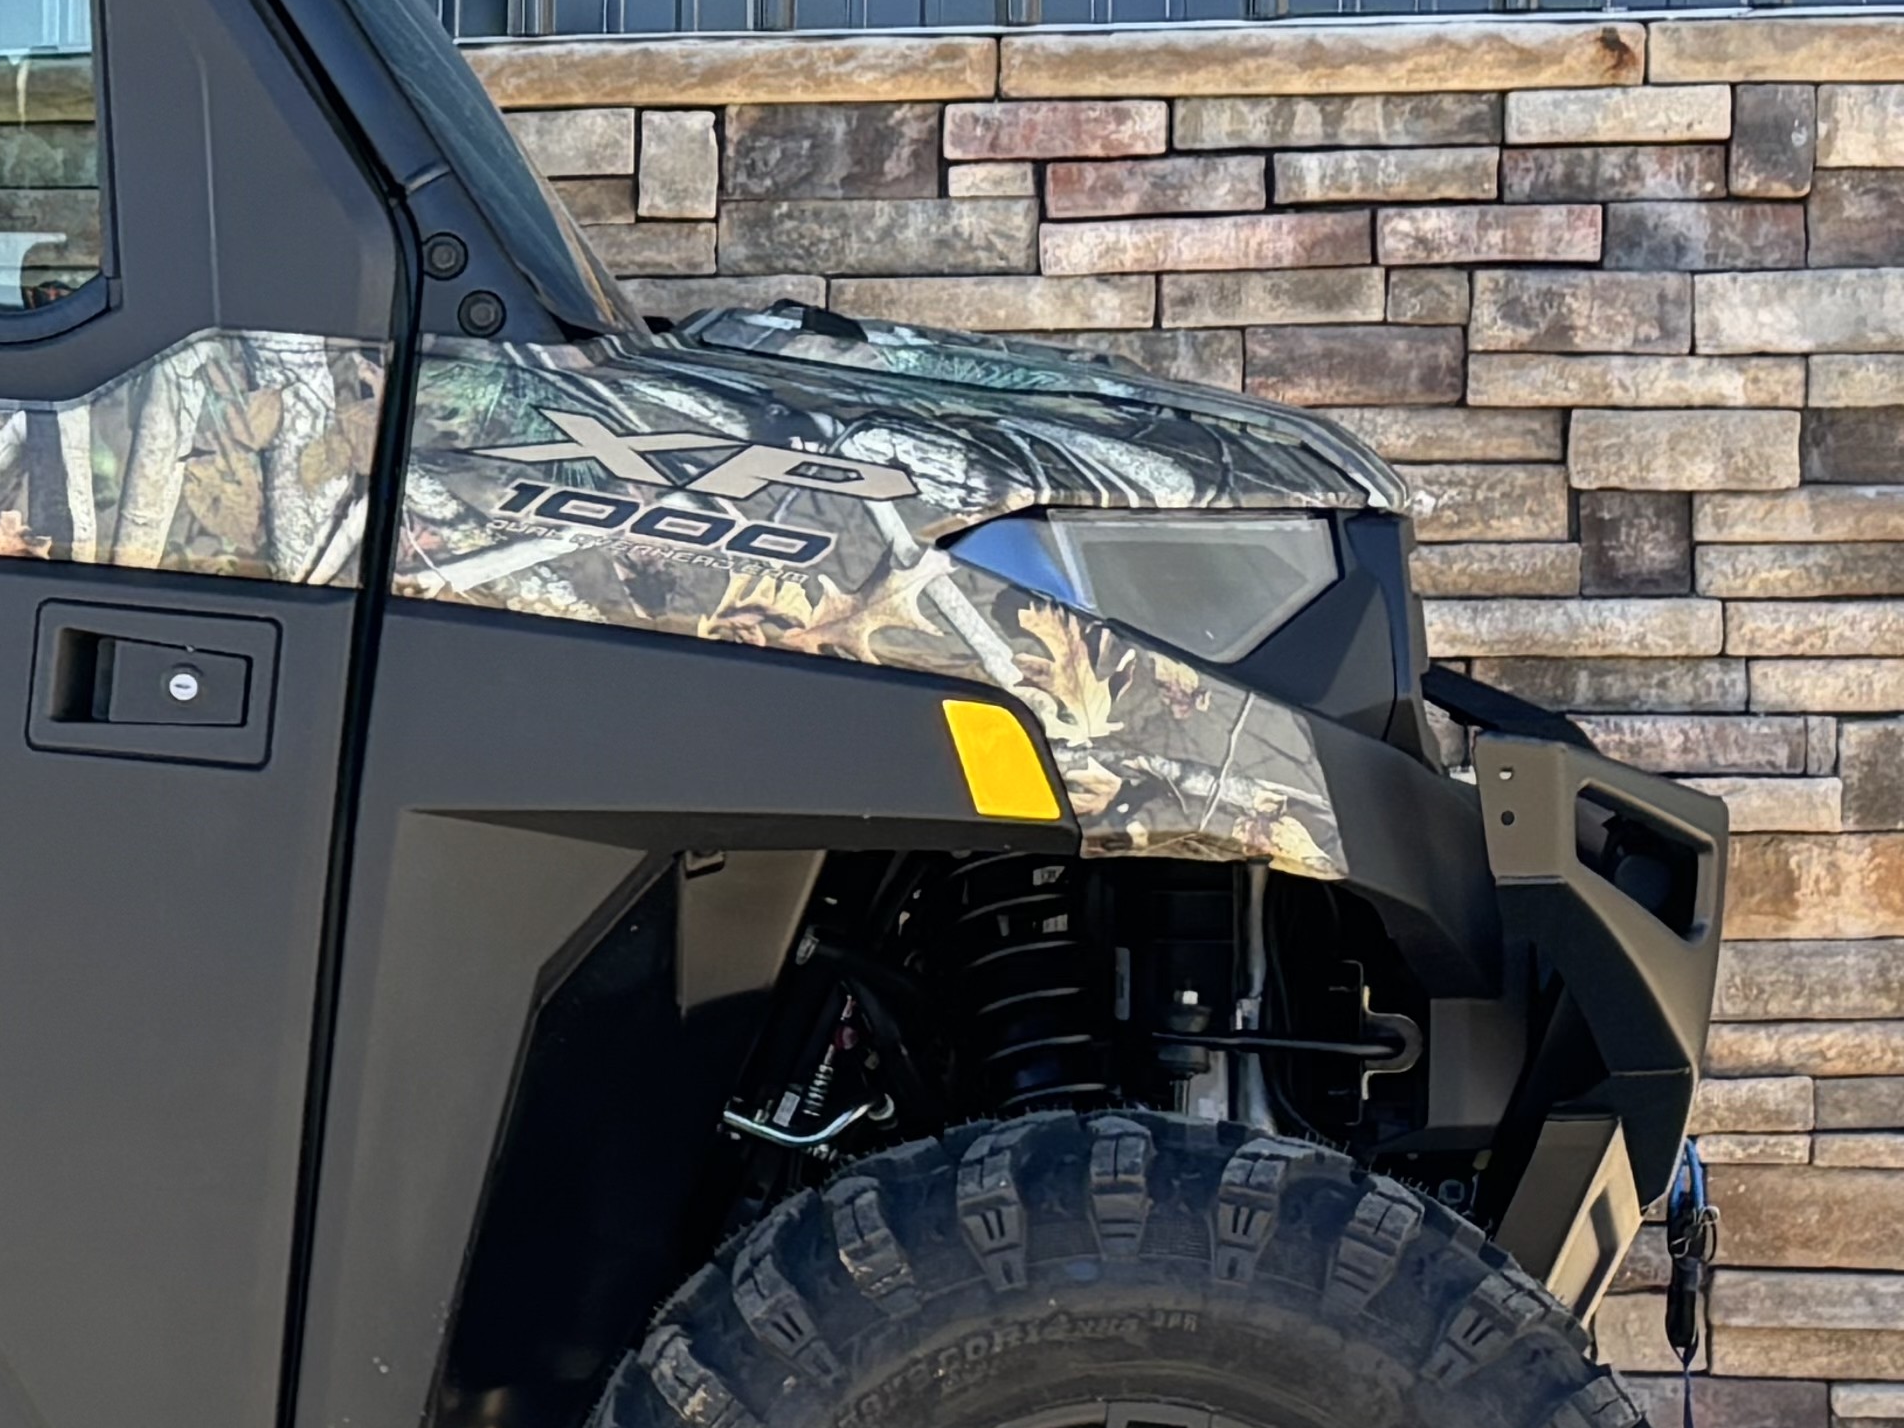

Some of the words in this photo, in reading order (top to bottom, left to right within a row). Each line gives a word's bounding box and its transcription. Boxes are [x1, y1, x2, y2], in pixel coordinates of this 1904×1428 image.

[464, 405, 921, 501] XP
[487, 517, 566, 542] DUAL
[571, 533, 736, 571] OVERHEAD
[492, 478, 837, 568] 1000
